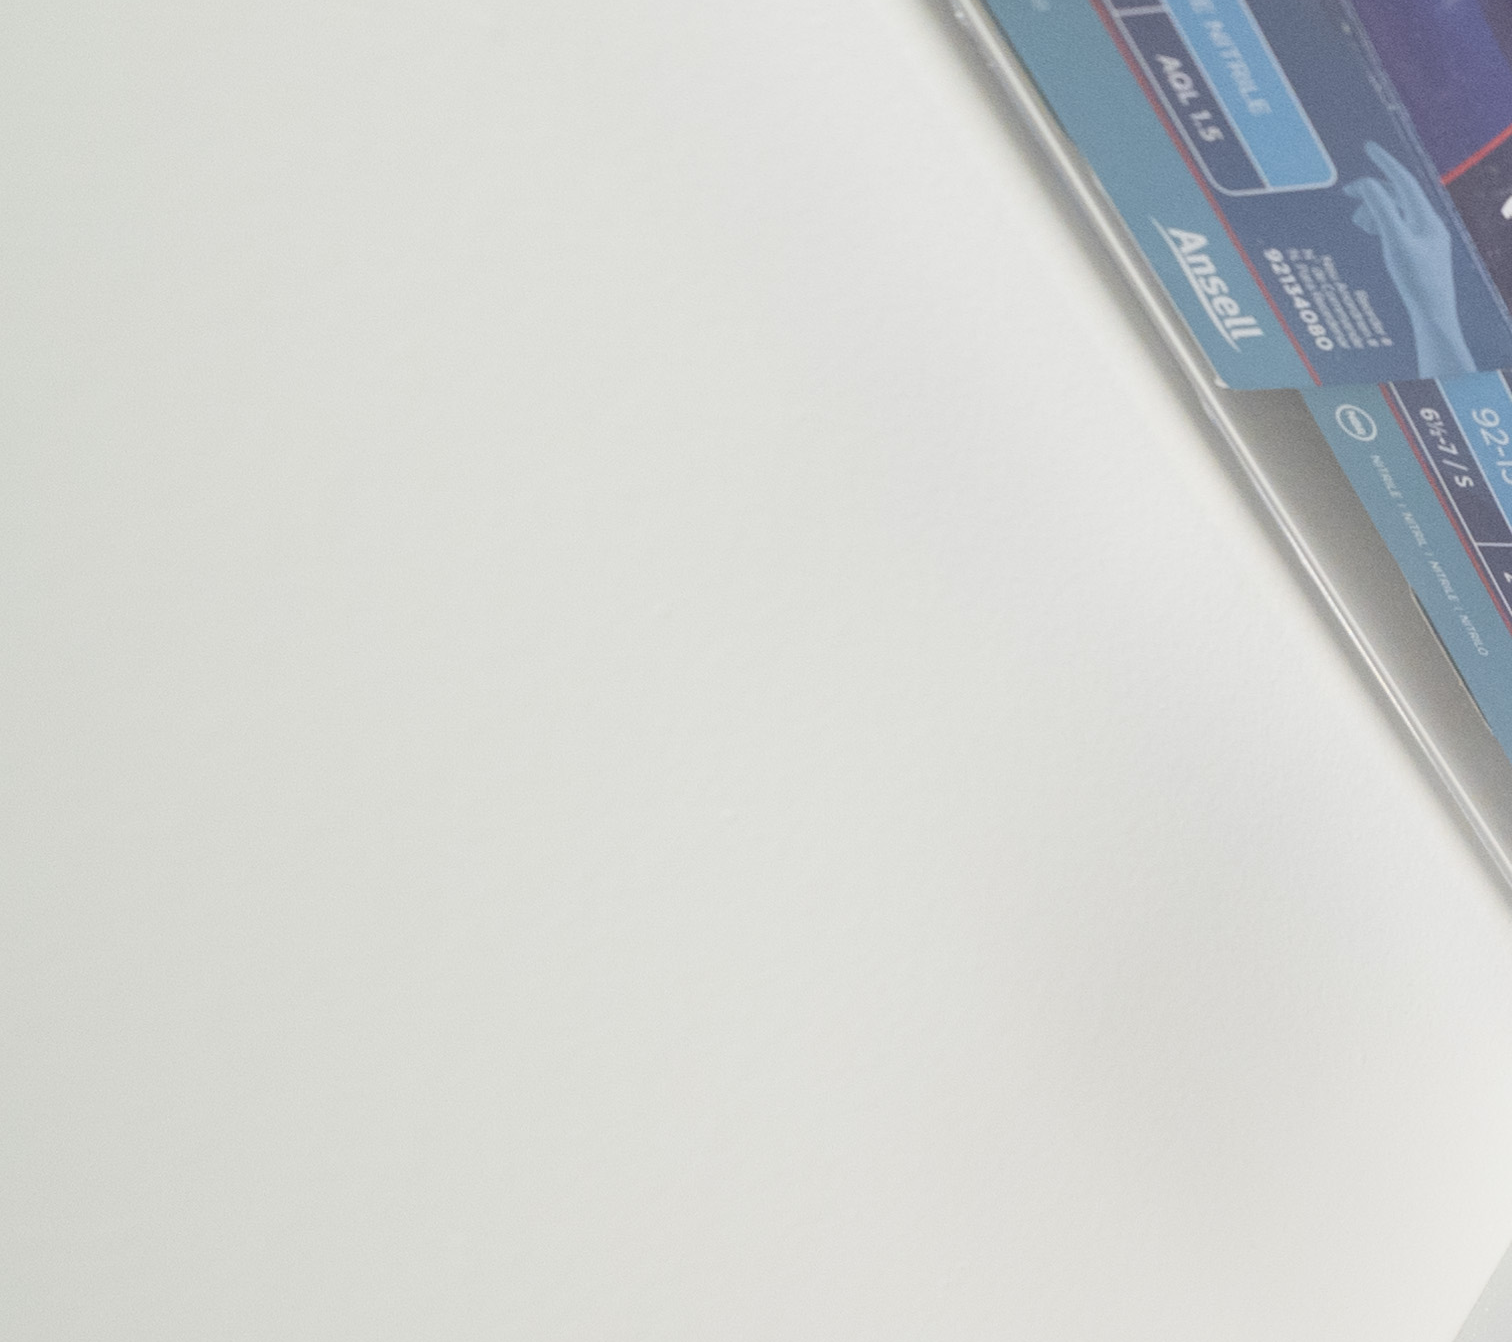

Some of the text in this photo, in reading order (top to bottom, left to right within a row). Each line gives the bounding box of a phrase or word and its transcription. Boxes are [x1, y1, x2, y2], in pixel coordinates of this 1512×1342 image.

[1155, 53, 1226, 143] AQL 1.5
[1167, 226, 1265, 341] Ansell
[1263, 247, 1335, 352] 92134080
[1454, 474, 1475, 489] S
